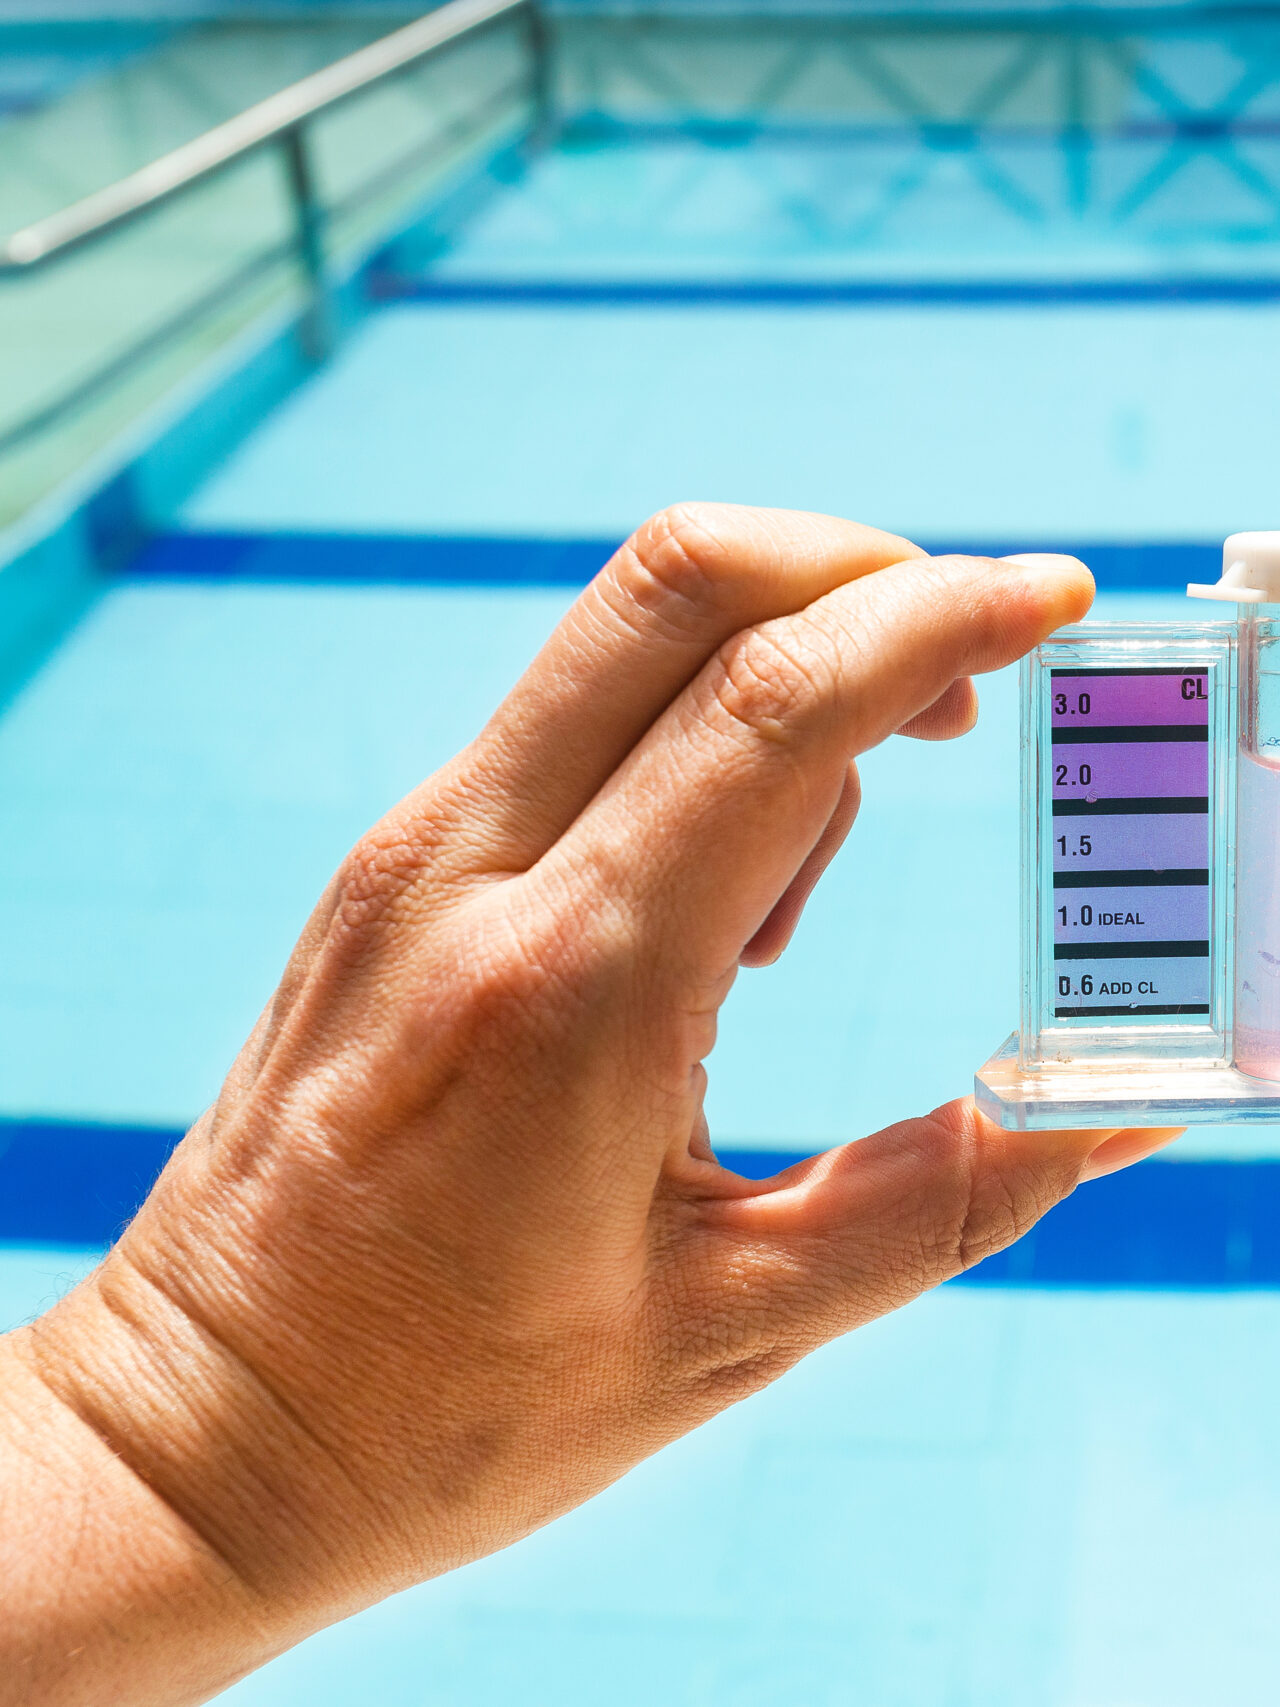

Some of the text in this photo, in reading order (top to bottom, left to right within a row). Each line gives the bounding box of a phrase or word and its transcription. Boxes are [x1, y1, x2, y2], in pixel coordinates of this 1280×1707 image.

[1181, 678, 1208, 700] CL
[1055, 693, 1091, 715] 3.0
[1055, 764, 1092, 786] 2.0
[1056, 835, 1092, 857] 1.5
[1057, 905, 1145, 927] 1.0 IDEAL
[1058, 974, 1159, 997] 0.6 ADD CL
